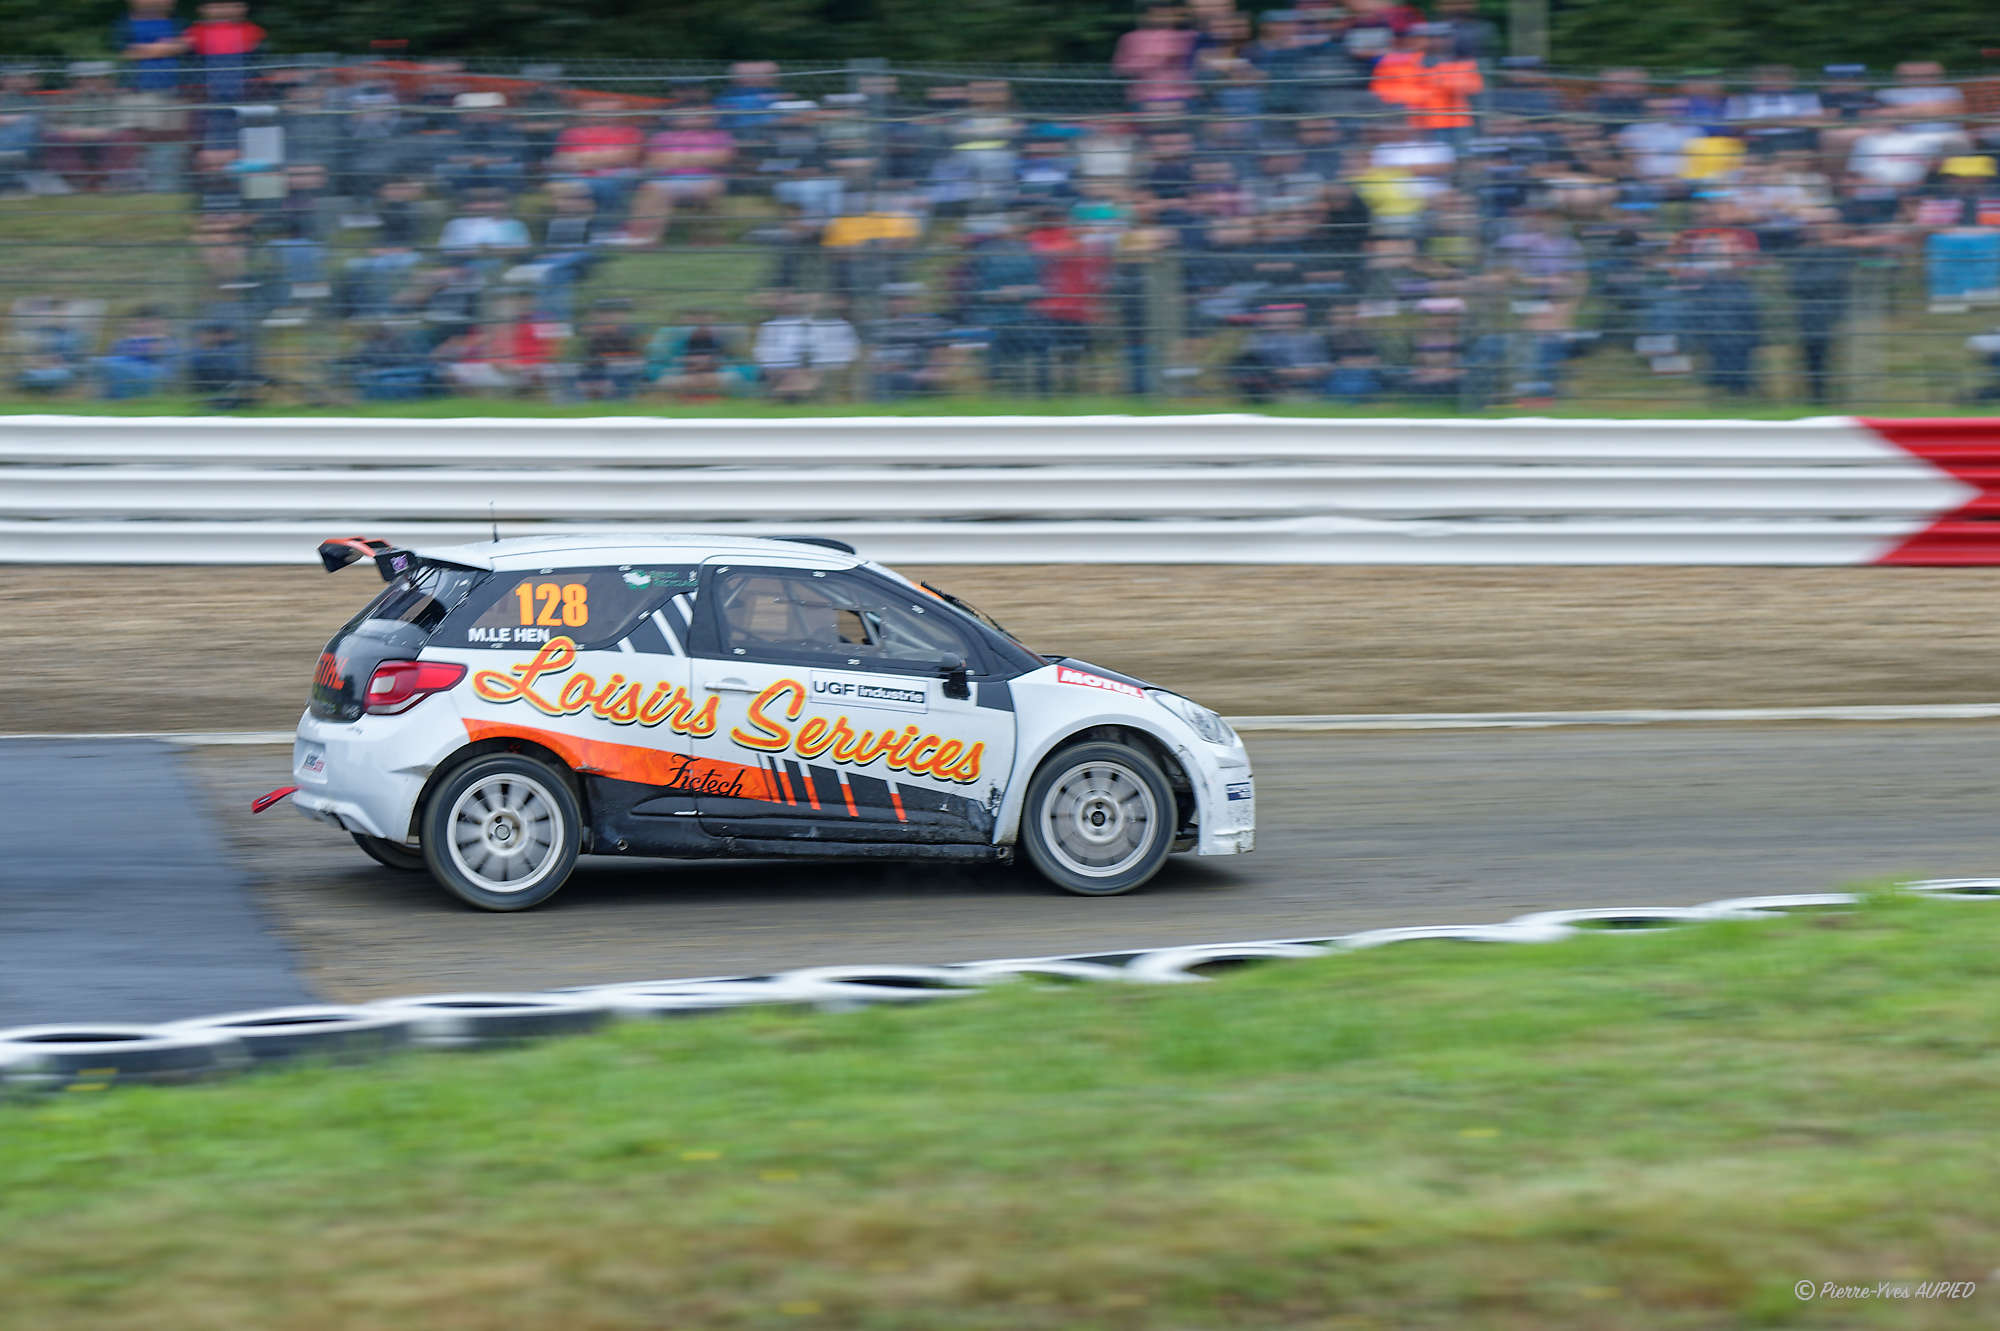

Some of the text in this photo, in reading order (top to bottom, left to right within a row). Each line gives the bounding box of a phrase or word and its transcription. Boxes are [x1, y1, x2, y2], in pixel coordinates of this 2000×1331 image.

[515, 582, 589, 627] 128
[513, 627, 551, 643] HEN
[814, 680, 925, 703] UGF industrie
[1060, 669, 1140, 697] MOTUL
[473, 636, 986, 784] Loisirs Services
